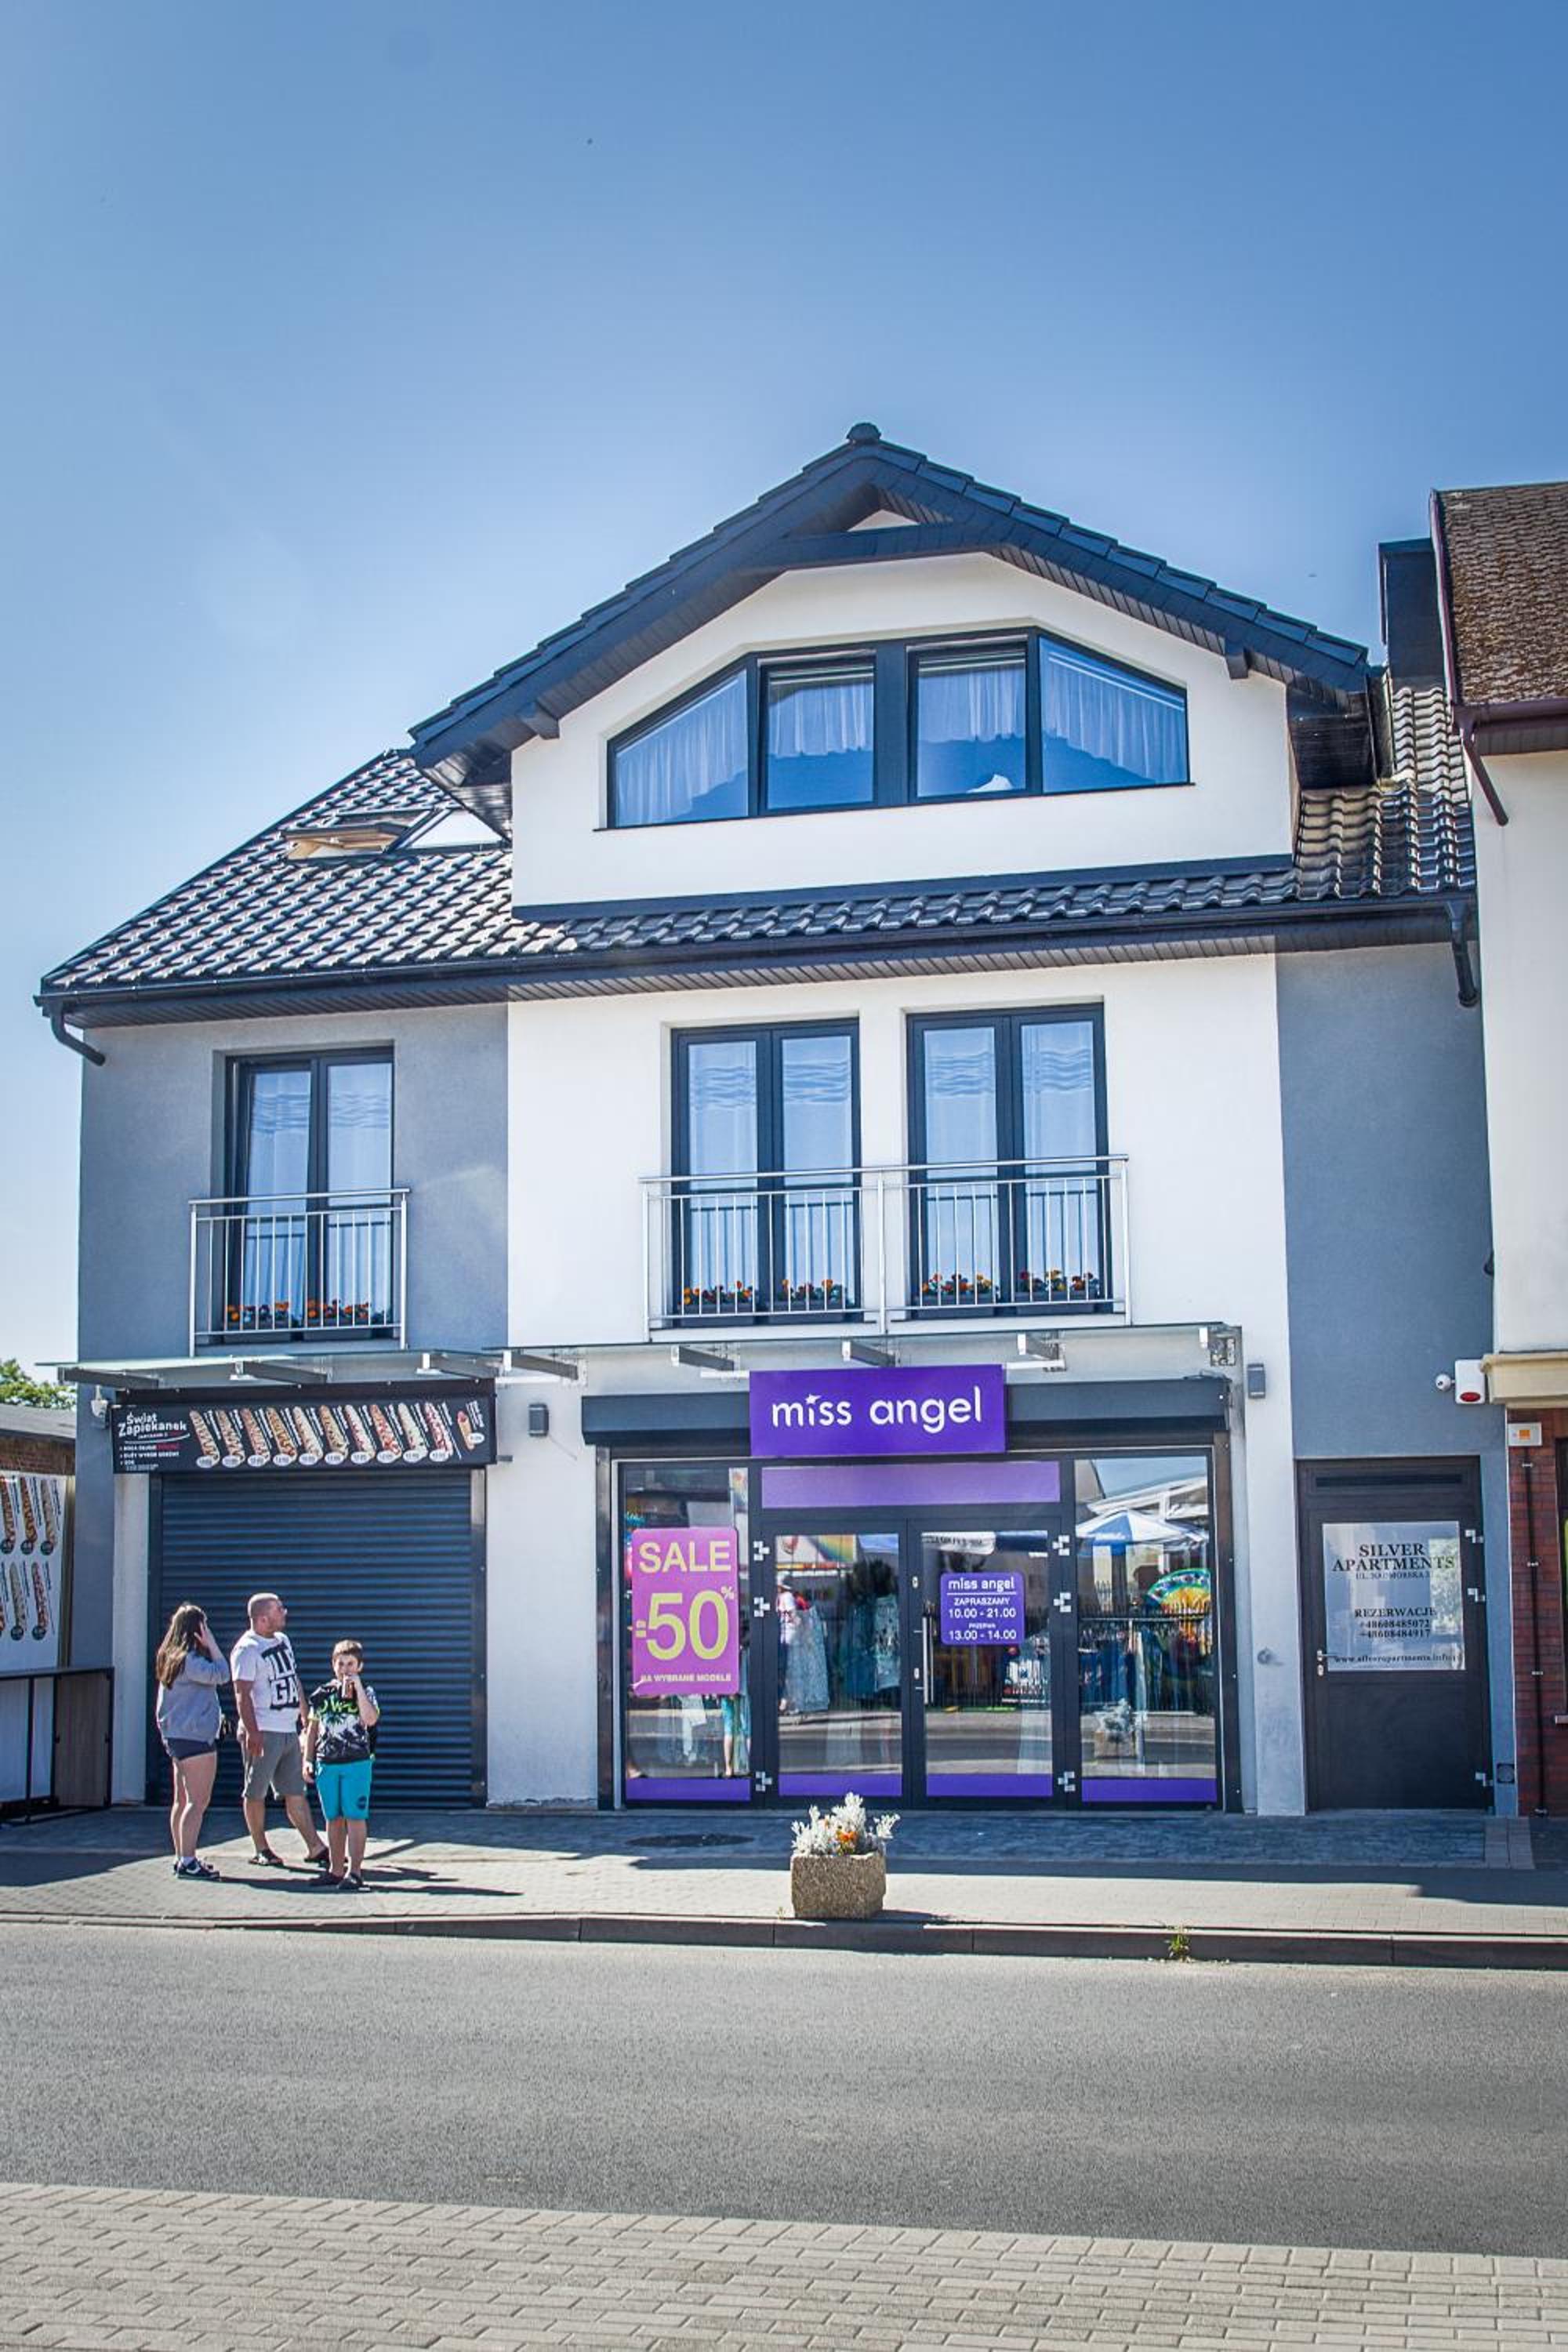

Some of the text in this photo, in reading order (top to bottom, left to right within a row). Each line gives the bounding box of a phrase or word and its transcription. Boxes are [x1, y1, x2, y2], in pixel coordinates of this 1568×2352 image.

[772, 1385, 982, 1434] miss angel
[126, 1411, 158, 1425] Świat
[118, 1420, 187, 1438] Zapiekanek
[638, 1540, 731, 1573] SALE
[1359, 1542, 1425, 1558] SILVER
[1332, 1555, 1456, 1572] APARTMENTS
[948, 1576, 1015, 1592] miss angel
[954, 1597, 1010, 1606] ZAPRASZAMY
[949, 1607, 978, 1619] 10.00
[986, 1607, 1017, 1618] 21.00
[1355, 1606, 1437, 1618] REZERWACJE
[949, 1629, 978, 1641] 13.00
[988, 1629, 1017, 1640] 14.00
[653, 1672, 695, 1682] WYBRANE
[696, 1672, 731, 1682] MODELE
